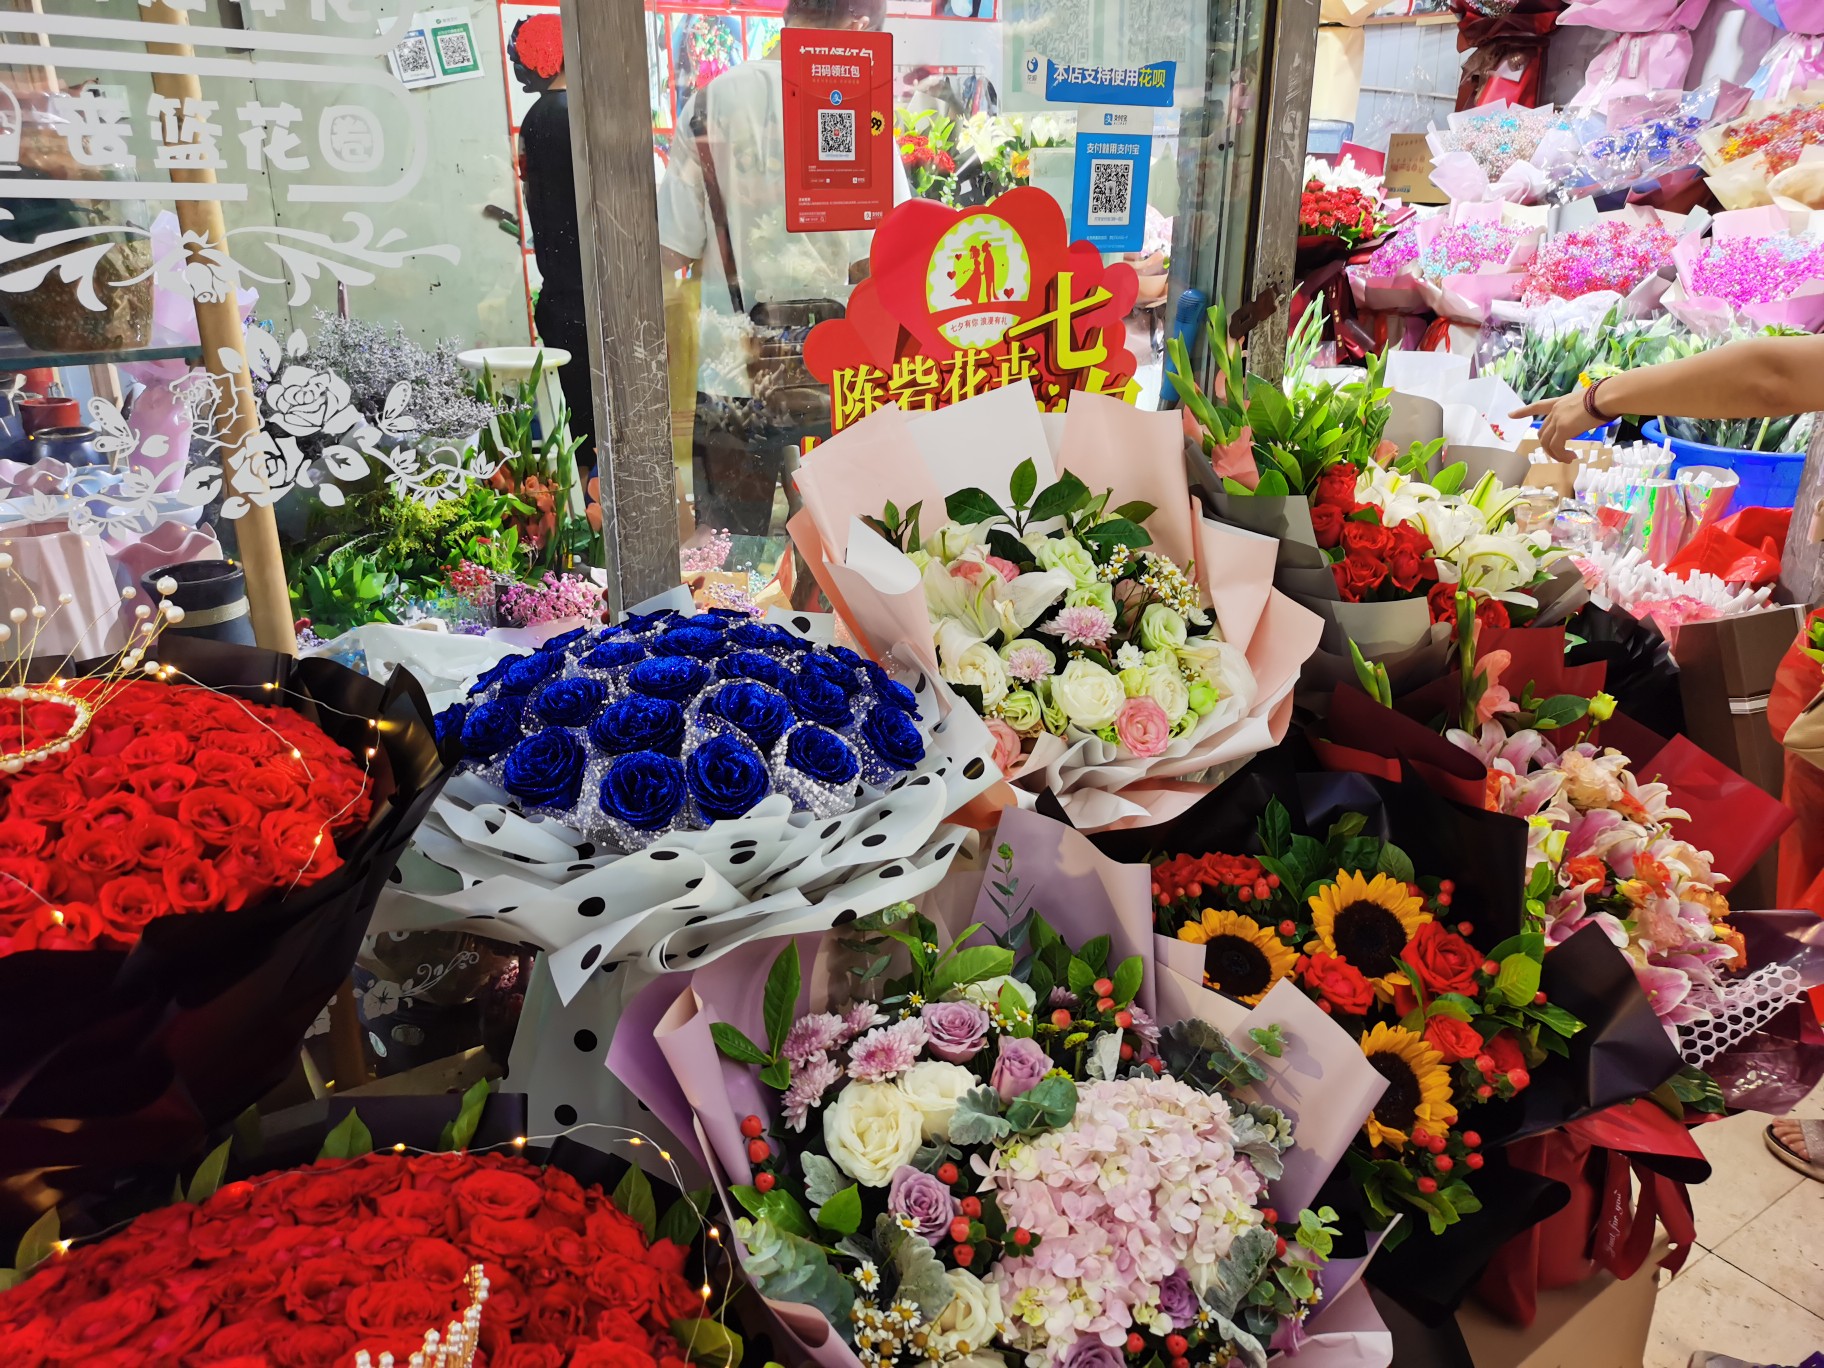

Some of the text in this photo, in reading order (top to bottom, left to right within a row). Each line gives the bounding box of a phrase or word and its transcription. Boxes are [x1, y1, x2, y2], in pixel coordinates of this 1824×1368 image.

[812, 64, 860, 78] 扫码领红包
[1053, 63, 1166, 88] 本店支持使用花呗
[950, 315, 1007, 333] 七夕有你 浪漫有礼
[1608, 1215, 1621, 1236] for
